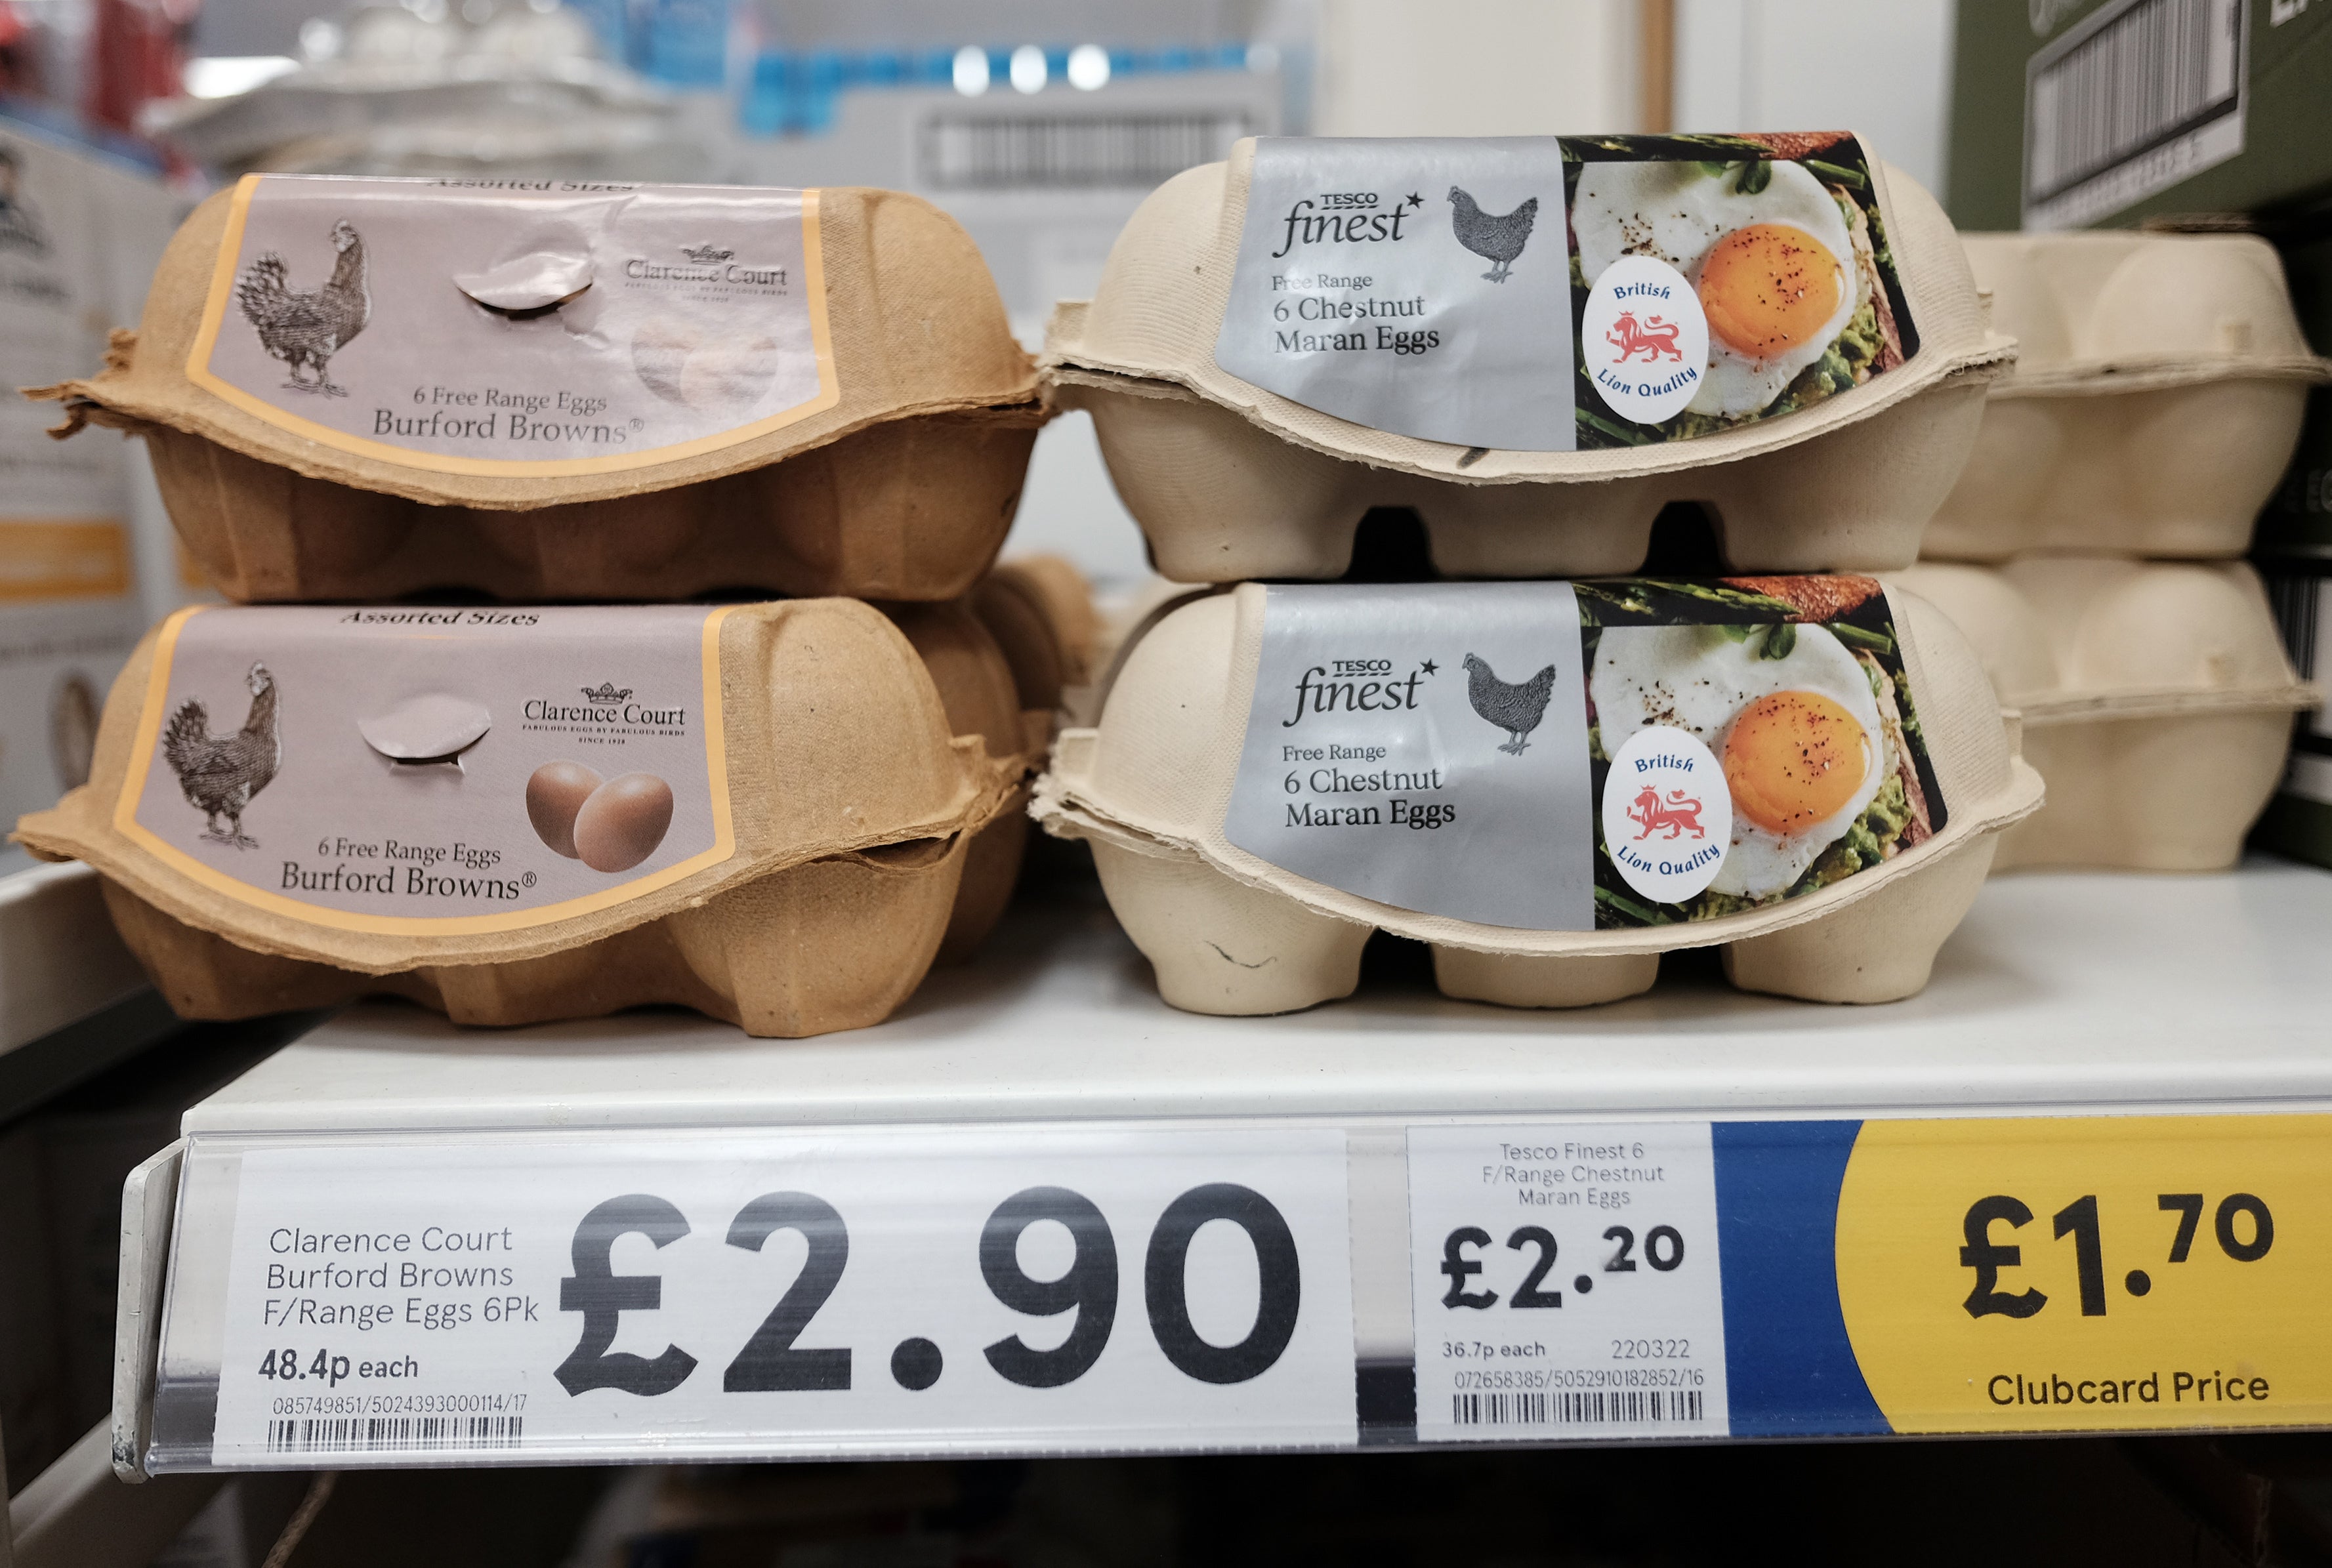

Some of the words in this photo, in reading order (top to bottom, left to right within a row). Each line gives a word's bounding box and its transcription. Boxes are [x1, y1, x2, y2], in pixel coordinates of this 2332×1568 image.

[1320, 192, 1379, 205] TESCO
[1272, 199, 1410, 258] finest
[626, 259, 719, 282] Clarence
[726, 265, 787, 286] Court
[1272, 275, 1312, 291] Free
[1318, 274, 1372, 291] Range
[1613, 283, 1671, 300] British
[1274, 300, 1289, 322] 6
[1299, 296, 1425, 320] Chestnut
[1274, 329, 1367, 354] Maran
[1375, 325, 1440, 356] Eggs
[1596, 368, 1631, 394] Lion
[1638, 366, 1697, 397] Quality
[413, 386, 425, 404] 6
[432, 386, 478, 406] Free
[485, 388, 550, 415] Range
[557, 390, 608, 417] Eggs
[373, 408, 496, 440] Burford
[341, 610, 461, 624] Assorted
[467, 610, 540, 626] Sizes
[1332, 659, 1391, 672] TESCO
[1282, 666, 1425, 728] finest
[524, 699, 617, 722] Clarence
[623, 703, 686, 726] Court
[1283, 745, 1323, 761] Free
[1329, 744, 1386, 762] Range
[1634, 754, 1694, 773] British
[1284, 770, 1301, 794] 6
[1309, 767, 1443, 793] Chestnut
[1285, 802, 1381, 827] Maran
[1389, 798, 1456, 830] Eggs
[318, 836, 329, 856] 6
[335, 837, 379, 858] Free
[385, 839, 446, 866] Range
[453, 842, 501, 869] Eggs
[1617, 845, 1652, 873] Lion
[1659, 844, 1720, 875] Quality
[281, 861, 394, 894] Burford
[1499, 1142, 1558, 1161] Tesco
[1564, 1142, 1626, 1160] Finest
[1632, 1142, 1644, 1159] 6
[1482, 1165, 1566, 1187] F/Range
[1572, 1164, 1664, 1182] Chestnut
[1518, 1187, 1580, 1205] Maran
[1587, 1187, 1631, 1209] Eggs
[270, 1227, 411, 1254] Clarence
[421, 1226, 513, 1251] Court
[1440, 1224, 1685, 1310] £2.20
[1959, 1192, 2274, 1319] £1.70
[266, 1262, 387, 1289] Burford
[400, 1262, 514, 1288] Browns
[553, 1181, 1301, 1397] £2.90
[264, 1296, 394, 1331] F/Range
[406, 1297, 472, 1330] Eggs
[484, 1295, 539, 1323] 6Pk
[1442, 1341, 1493, 1360] 36.7p
[1501, 1340, 1546, 1357] each
[1612, 1339, 1690, 1359] 220322
[259, 1348, 350, 1388] 48.4p
[358, 1354, 419, 1378] each
[1988, 1371, 2159, 1405] Clubcard
[2173, 1369, 2269, 1403] Price
[273, 1393, 528, 1415] 085749851/5024393000114/17
